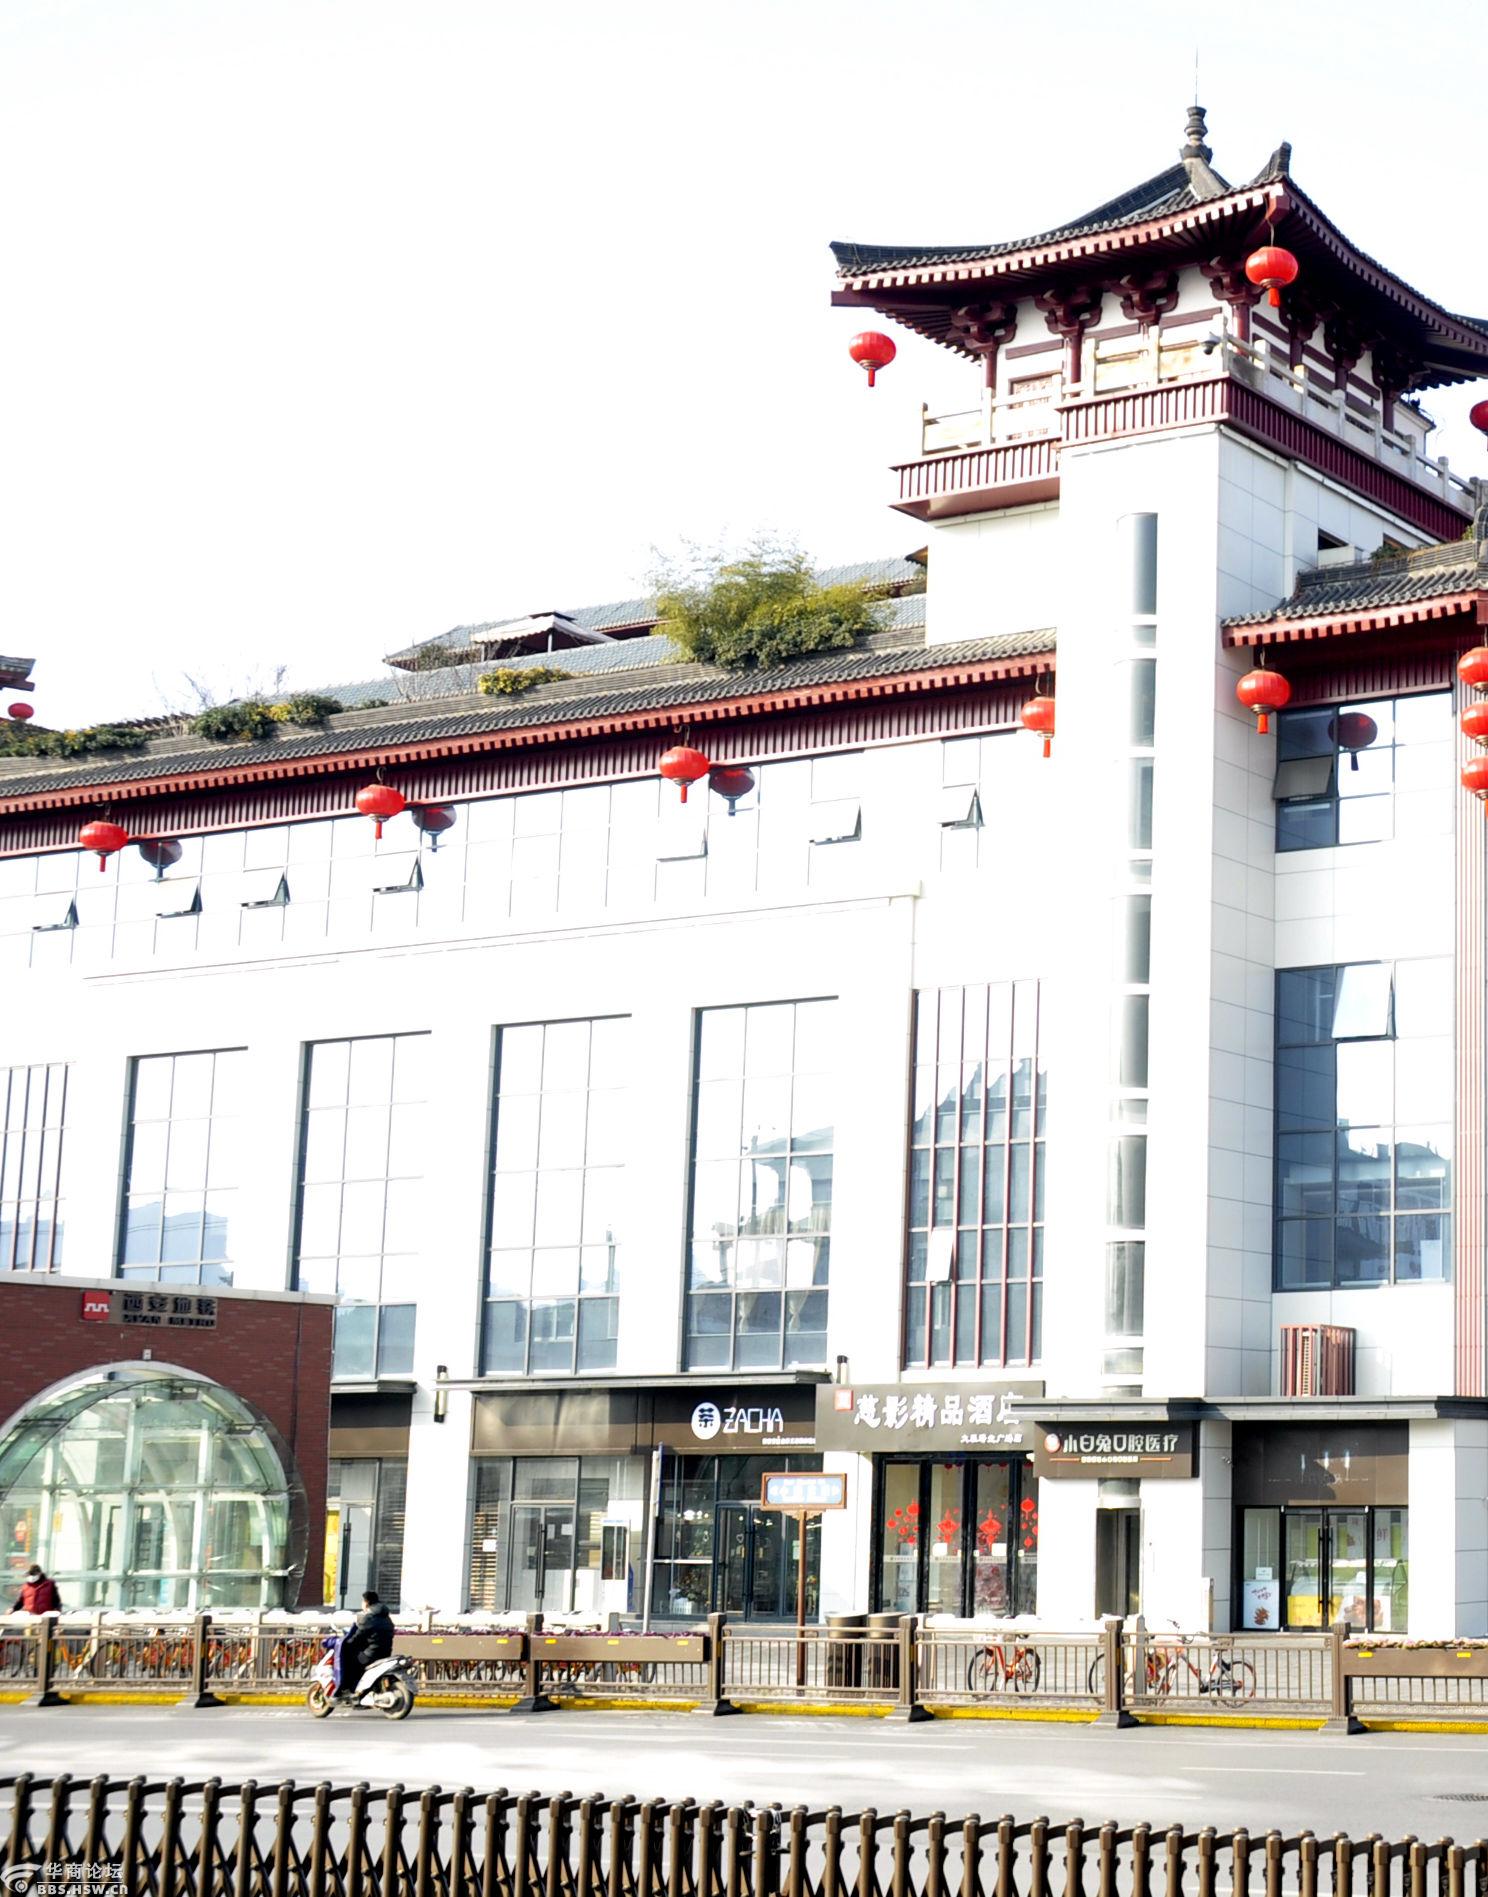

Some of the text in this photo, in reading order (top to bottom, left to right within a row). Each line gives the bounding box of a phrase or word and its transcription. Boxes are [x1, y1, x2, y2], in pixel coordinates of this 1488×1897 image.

[1063, 1433, 1179, 1453] 小白兔口腔医疗
